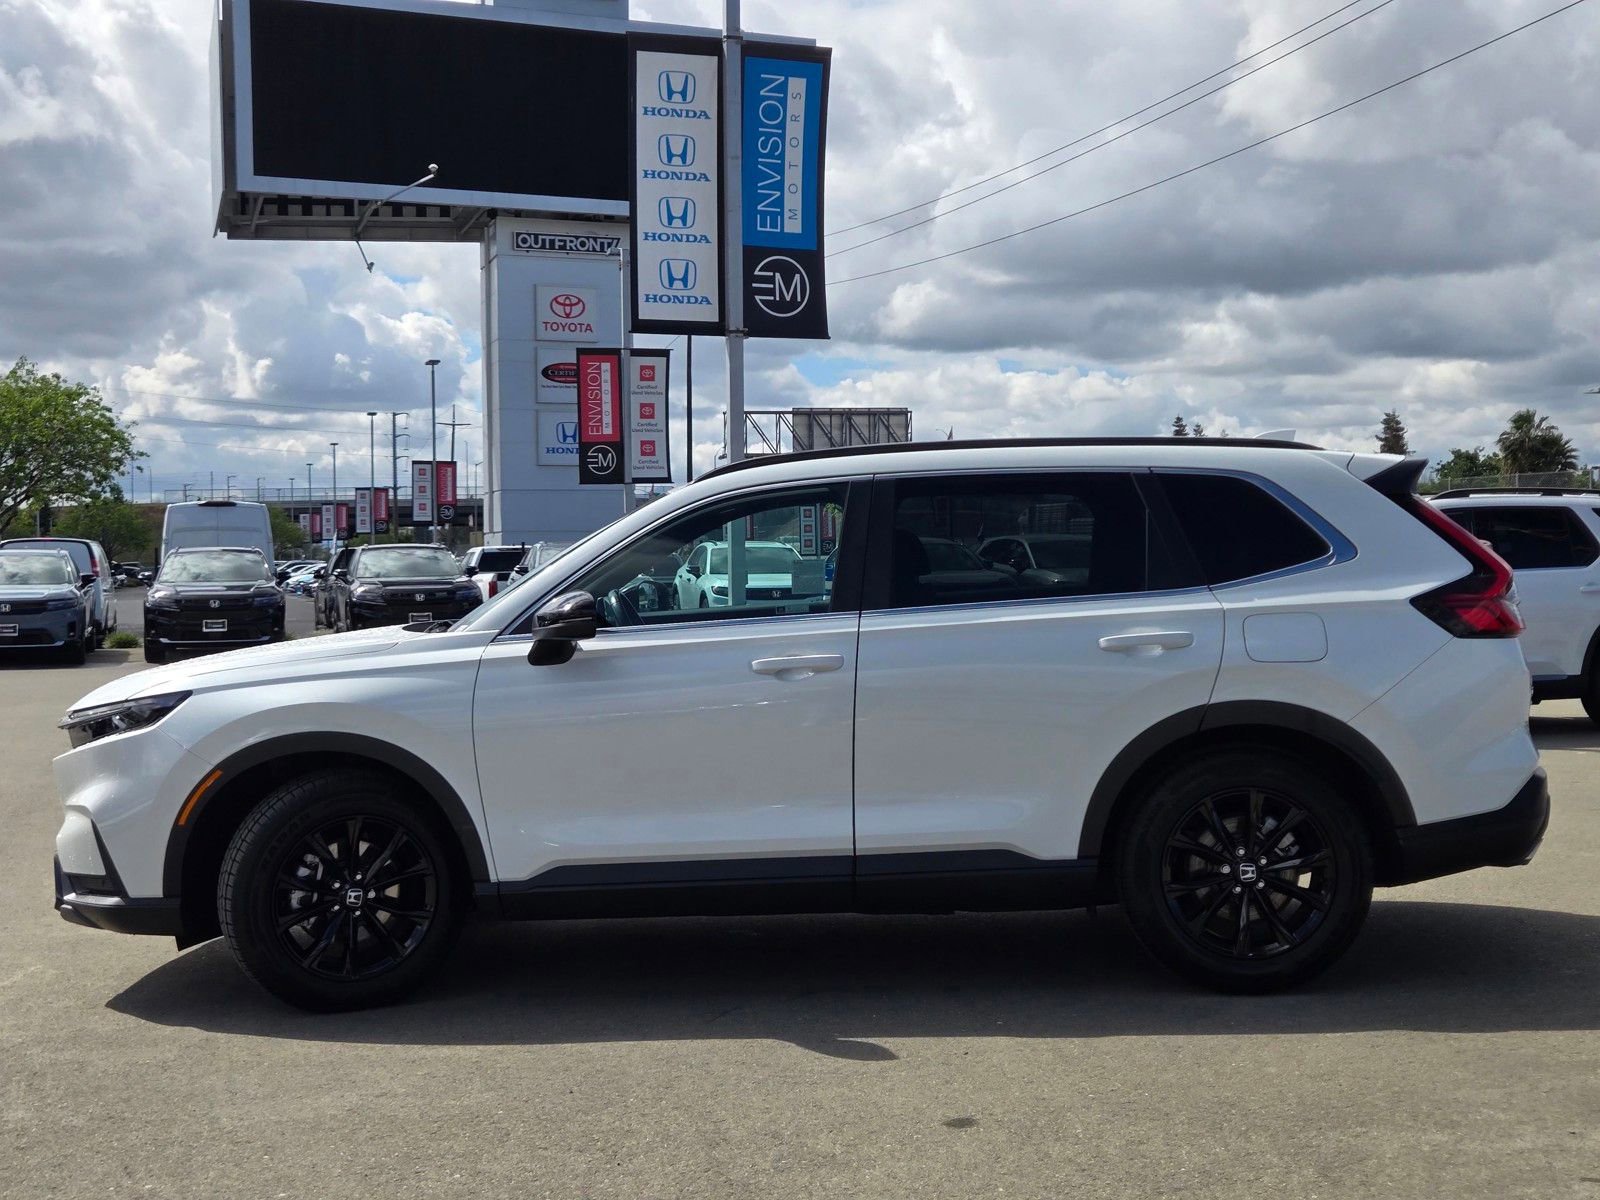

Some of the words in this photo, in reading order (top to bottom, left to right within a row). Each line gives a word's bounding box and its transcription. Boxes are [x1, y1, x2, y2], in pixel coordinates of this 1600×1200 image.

[642, 106, 711, 119] HONDA
[757, 74, 785, 233] ENVISION
[789, 91, 802, 220] MOTORS
[642, 169, 711, 182] HONDA
[643, 232, 712, 244] HONDA
[644, 293, 712, 305] HONDA
[542, 321, 593, 333] TOYOTA
[587, 362, 602, 435] ENVISION
